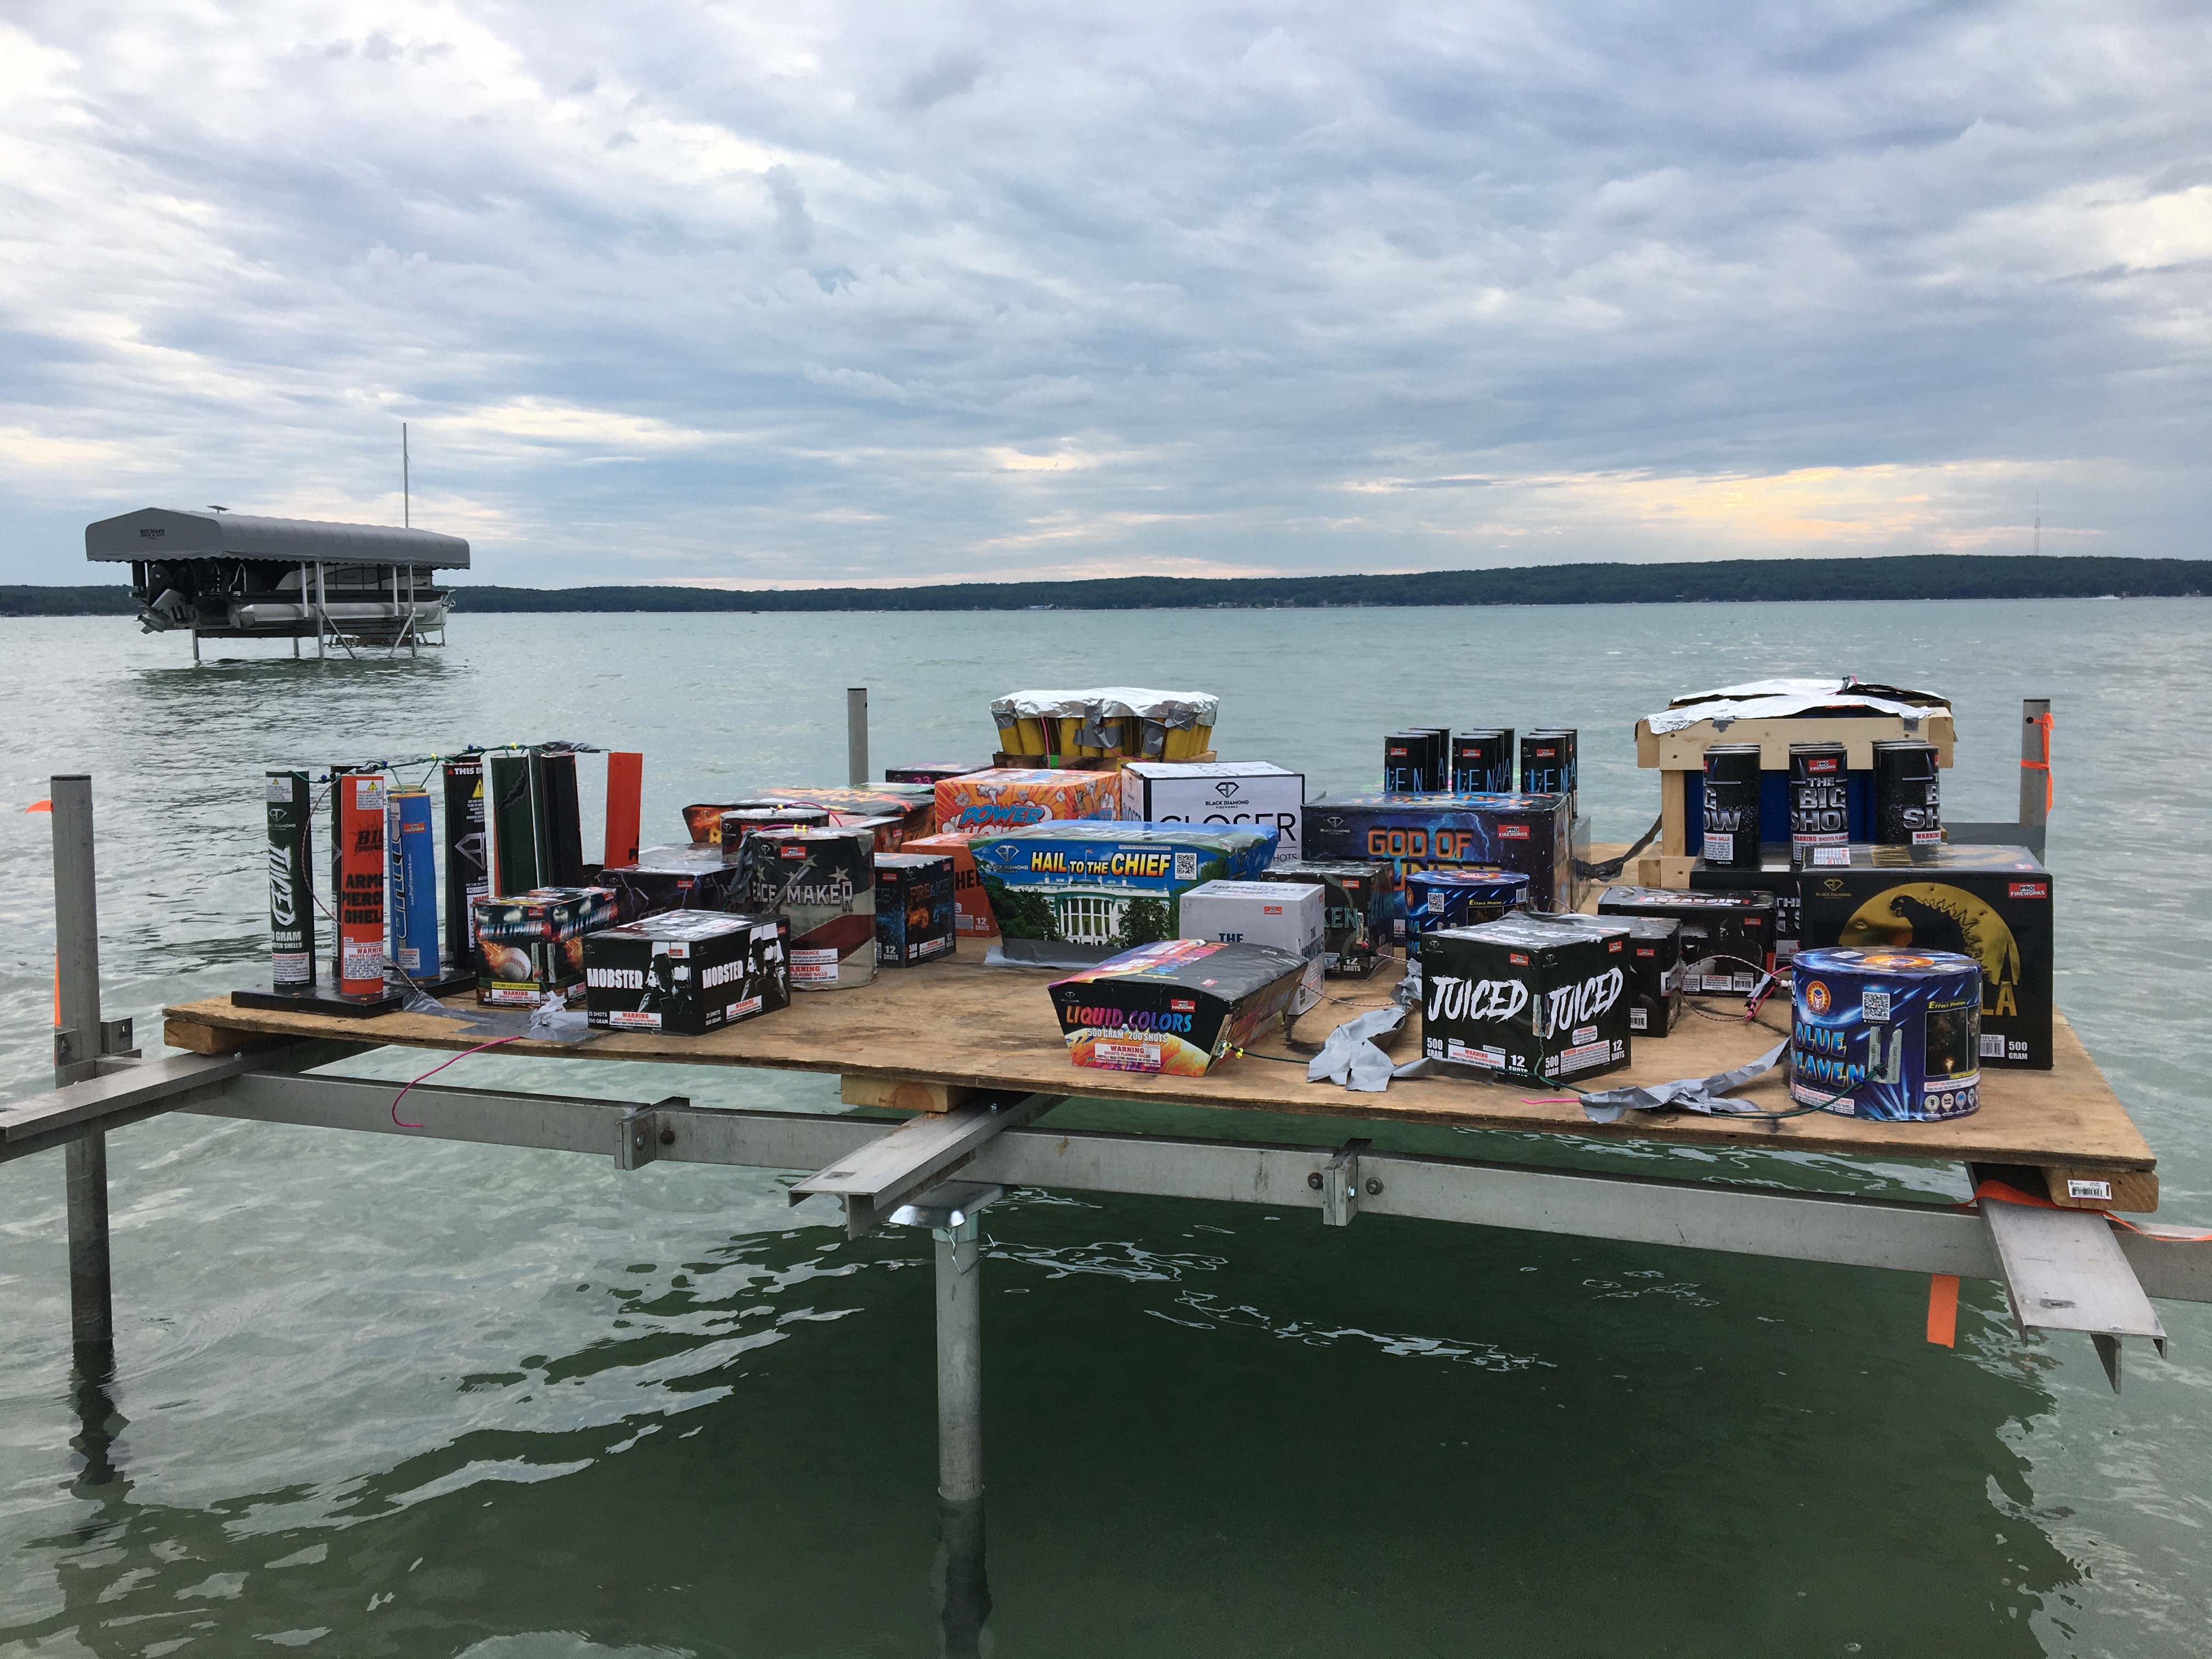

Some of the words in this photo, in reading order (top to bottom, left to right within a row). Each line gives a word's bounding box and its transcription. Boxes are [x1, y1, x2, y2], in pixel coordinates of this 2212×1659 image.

[1807, 777, 1835, 787] THE
[961, 804, 1045, 825] POWER
[1368, 826, 1427, 857] GOD
[1435, 828, 1474, 859] OF
[1031, 851, 1068, 873] HAIL
[1069, 861, 1085, 873] TO
[1086, 861, 1108, 875] THE
[1111, 853, 1172, 877] CHIEF
[786, 881, 854, 912] MAKER
[275, 931, 301, 941] GRAM
[946, 933, 952, 941] 12
[1218, 933, 1244, 942] THE
[884, 945, 896, 954] 12
[586, 967, 644, 990] MOBSTER
[702, 960, 744, 989] MOBSTER
[1427, 974, 1528, 1024] JUICED
[1545, 965, 1623, 1040] JUICED
[1066, 1004, 1124, 1027] LIQUID
[1128, 1009, 1193, 1033] COLORS
[1087, 1028, 1102, 1037] 500
[1103, 1029, 1124, 1039] GRAM
[1128, 1031, 1143, 1041] 200
[1144, 1033, 1167, 1043] SHOTS
[1796, 1020, 1847, 1059] BLUE
[1110, 1045, 1144, 1054] WARNING
[1426, 1036, 1443, 1051] 500
[1612, 1039, 1623, 1052] 12
[2008, 1041, 2028, 1051] 500
[1426, 1048, 1443, 1058] GRAM
[1464, 1049, 1489, 1059] WARNING
[1611, 1050, 1625, 1061] SHOTS
[1510, 1054, 1526, 1068] 12
[1545, 1054, 1559, 1069] 500
[1545, 1066, 1559, 1077] GRAM
